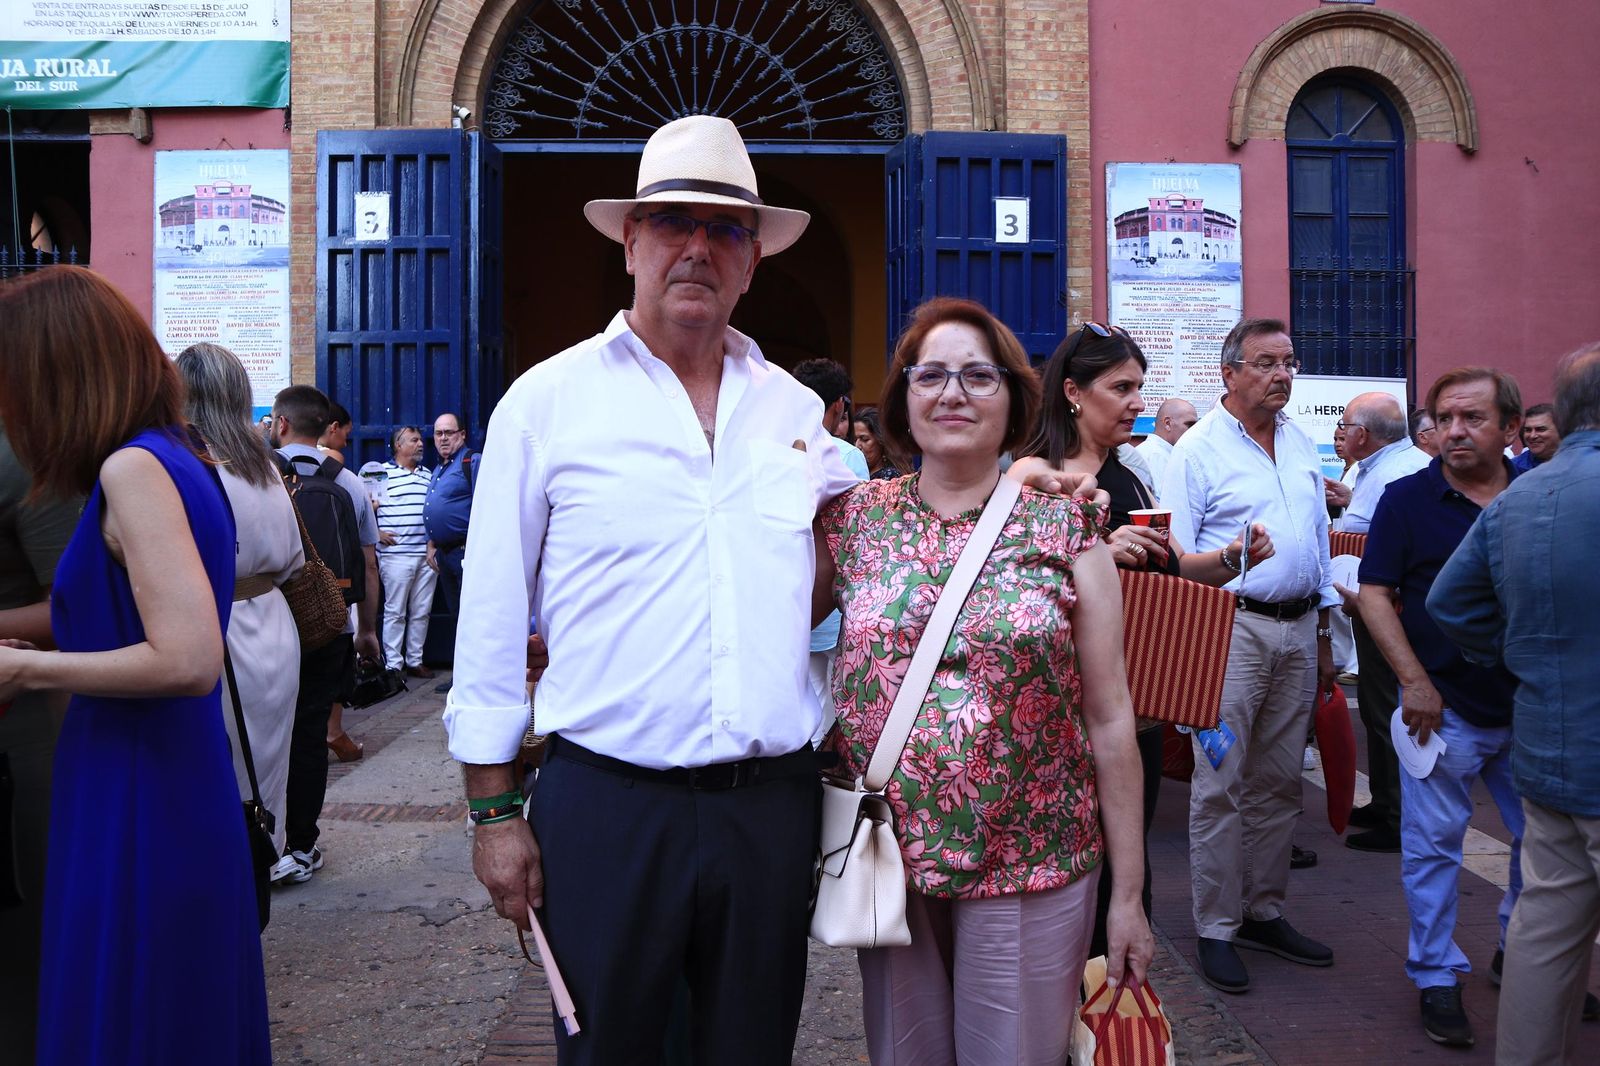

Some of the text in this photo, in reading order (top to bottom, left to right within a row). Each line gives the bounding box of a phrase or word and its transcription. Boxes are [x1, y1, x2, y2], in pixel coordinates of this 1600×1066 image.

[138, 20, 166, 28] LUNES
[34, 58, 117, 77] RURAL
[14, 80, 80, 91] DEL SUR
[199, 164, 248, 177] HUELVA
[1151, 177, 1200, 190] HUELVA
[1003, 213, 1019, 237] 3
[1298, 405, 1312, 415] LA
